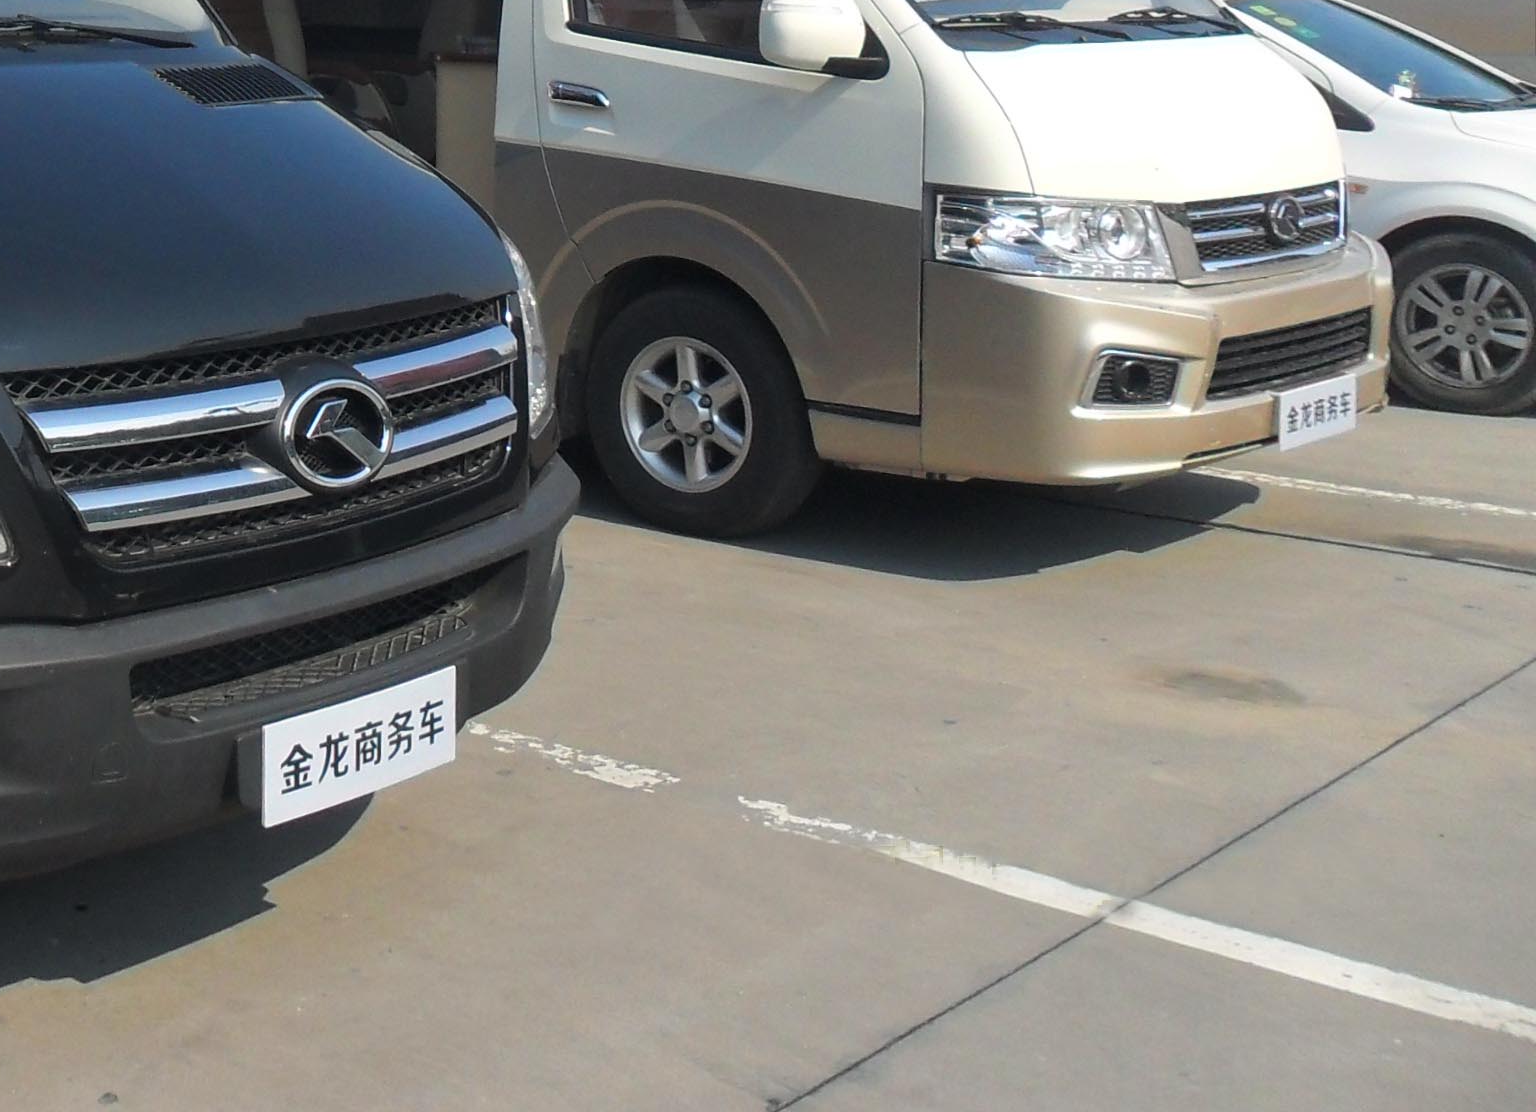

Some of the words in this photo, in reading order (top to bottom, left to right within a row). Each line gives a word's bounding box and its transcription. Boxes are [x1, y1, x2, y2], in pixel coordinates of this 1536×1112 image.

[1286, 391, 1353, 434] 金龙商务车
[280, 698, 445, 795] 金龙商务车
